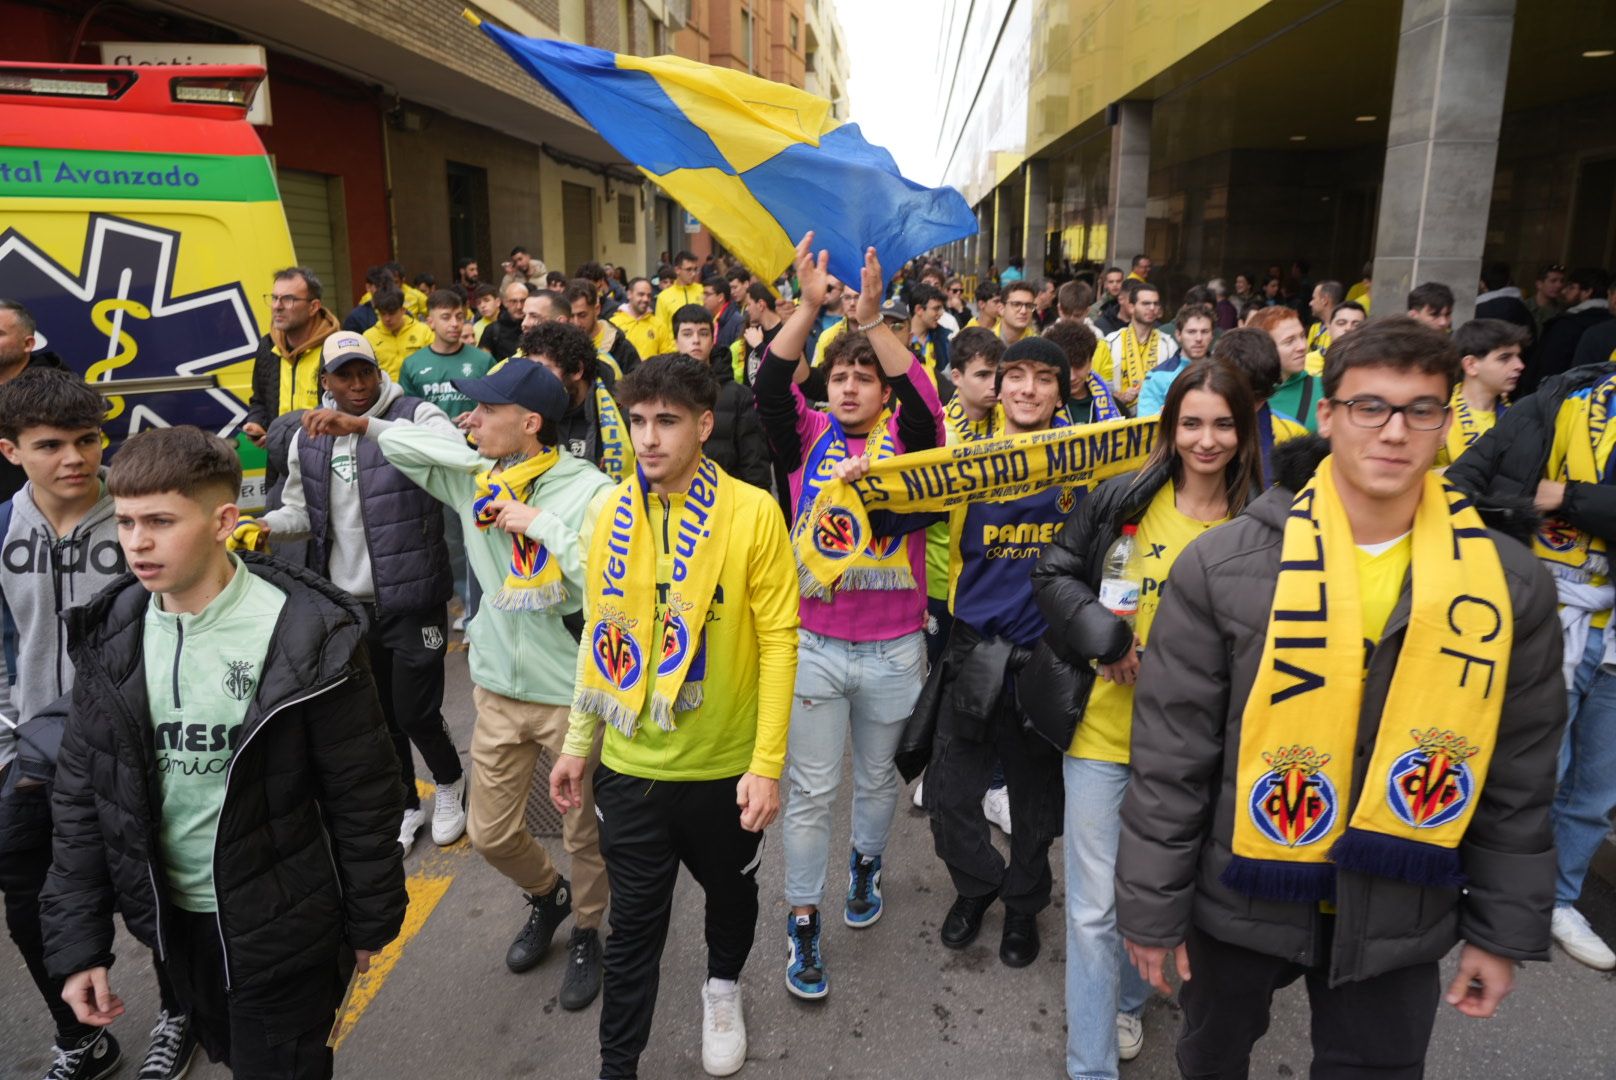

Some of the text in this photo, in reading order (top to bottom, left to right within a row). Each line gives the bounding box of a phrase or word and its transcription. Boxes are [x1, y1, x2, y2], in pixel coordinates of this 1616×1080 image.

[54, 161, 200, 187] Avanzado
[855, 421, 1159, 507] ES NUESTRO MOMENT
[1439, 594, 1502, 700] CF
